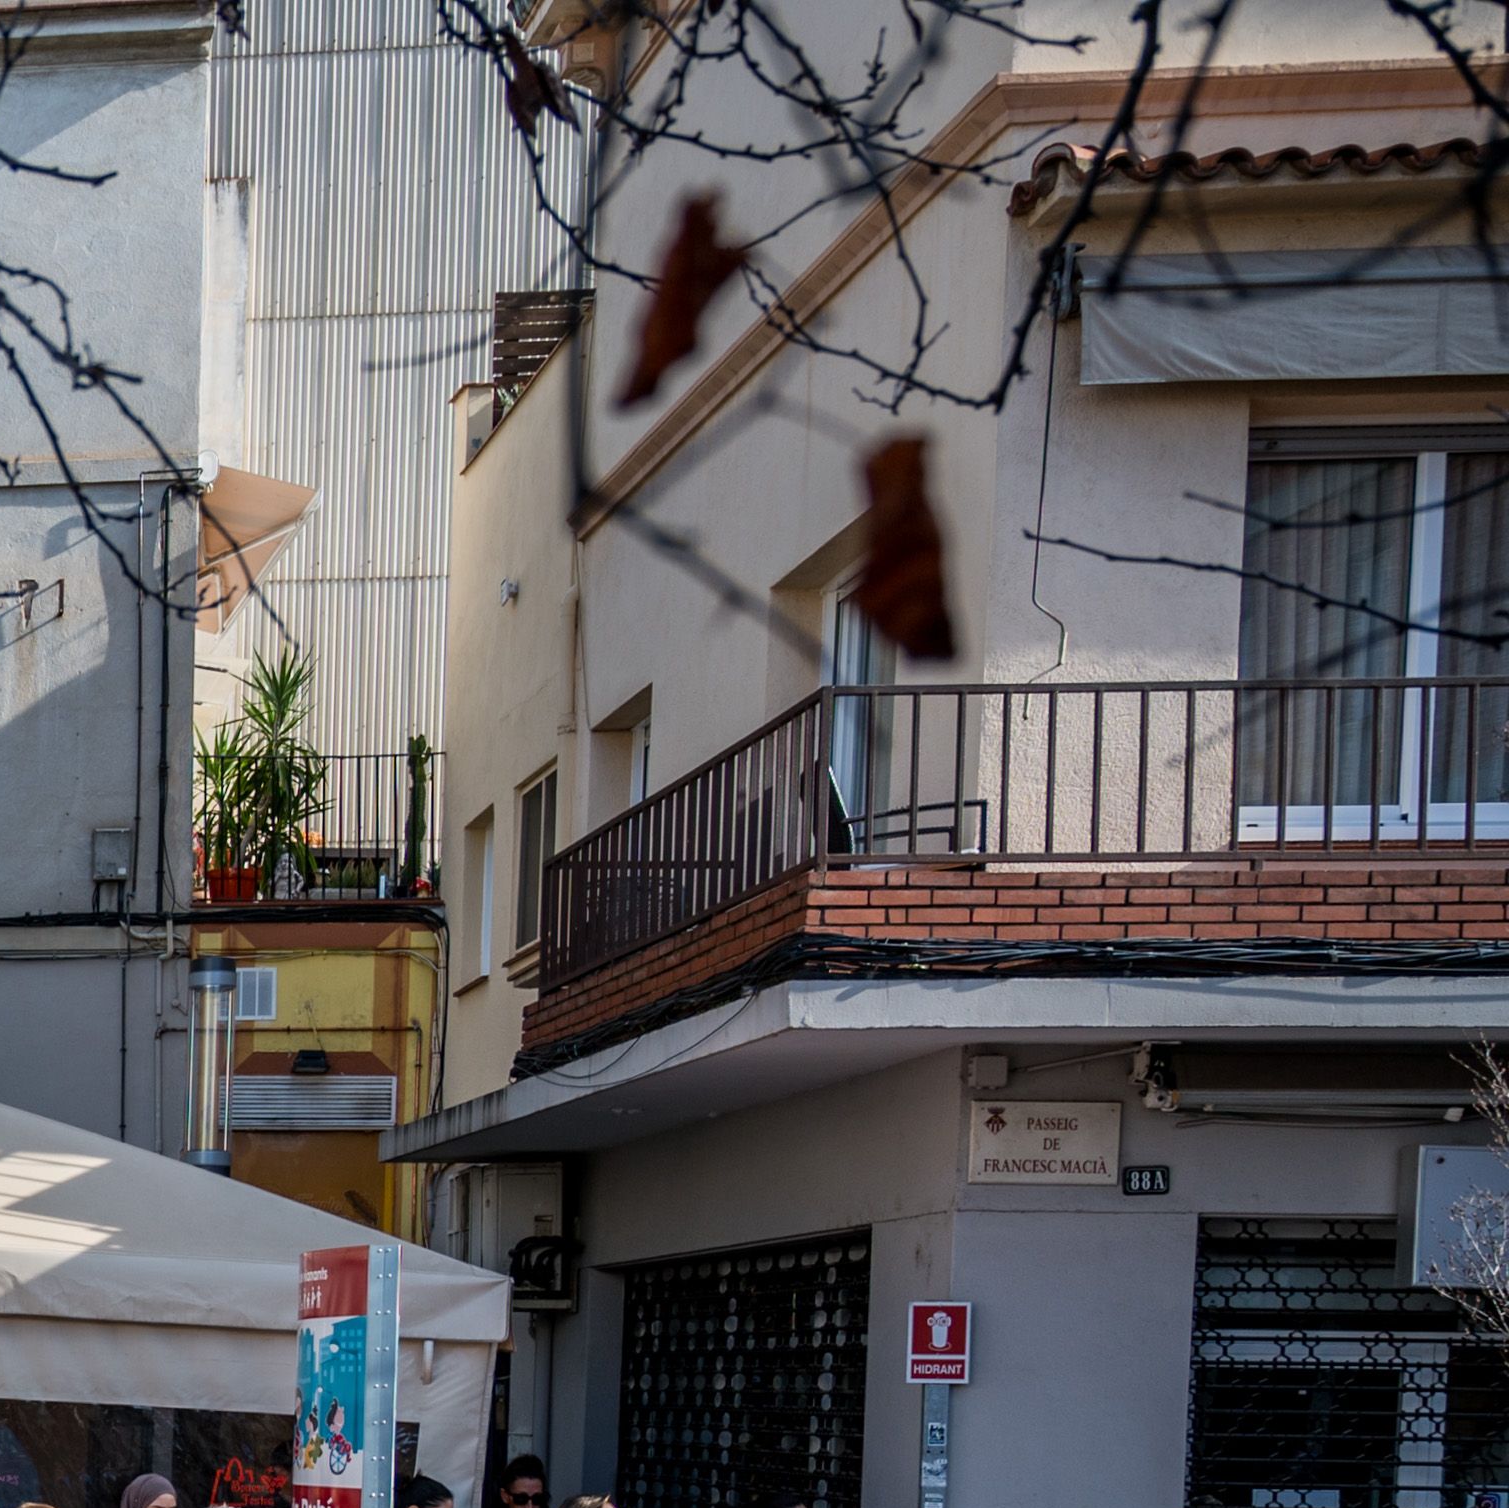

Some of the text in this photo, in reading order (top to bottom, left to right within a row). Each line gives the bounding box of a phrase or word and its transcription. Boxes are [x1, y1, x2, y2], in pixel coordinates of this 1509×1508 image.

[1026, 1117, 1079, 1131] PASSEIG
[1043, 1138, 1062, 1151] DE
[983, 1155, 1108, 1175] FRANCESC MACIÀ
[913, 1364, 963, 1375] HIDRANT
